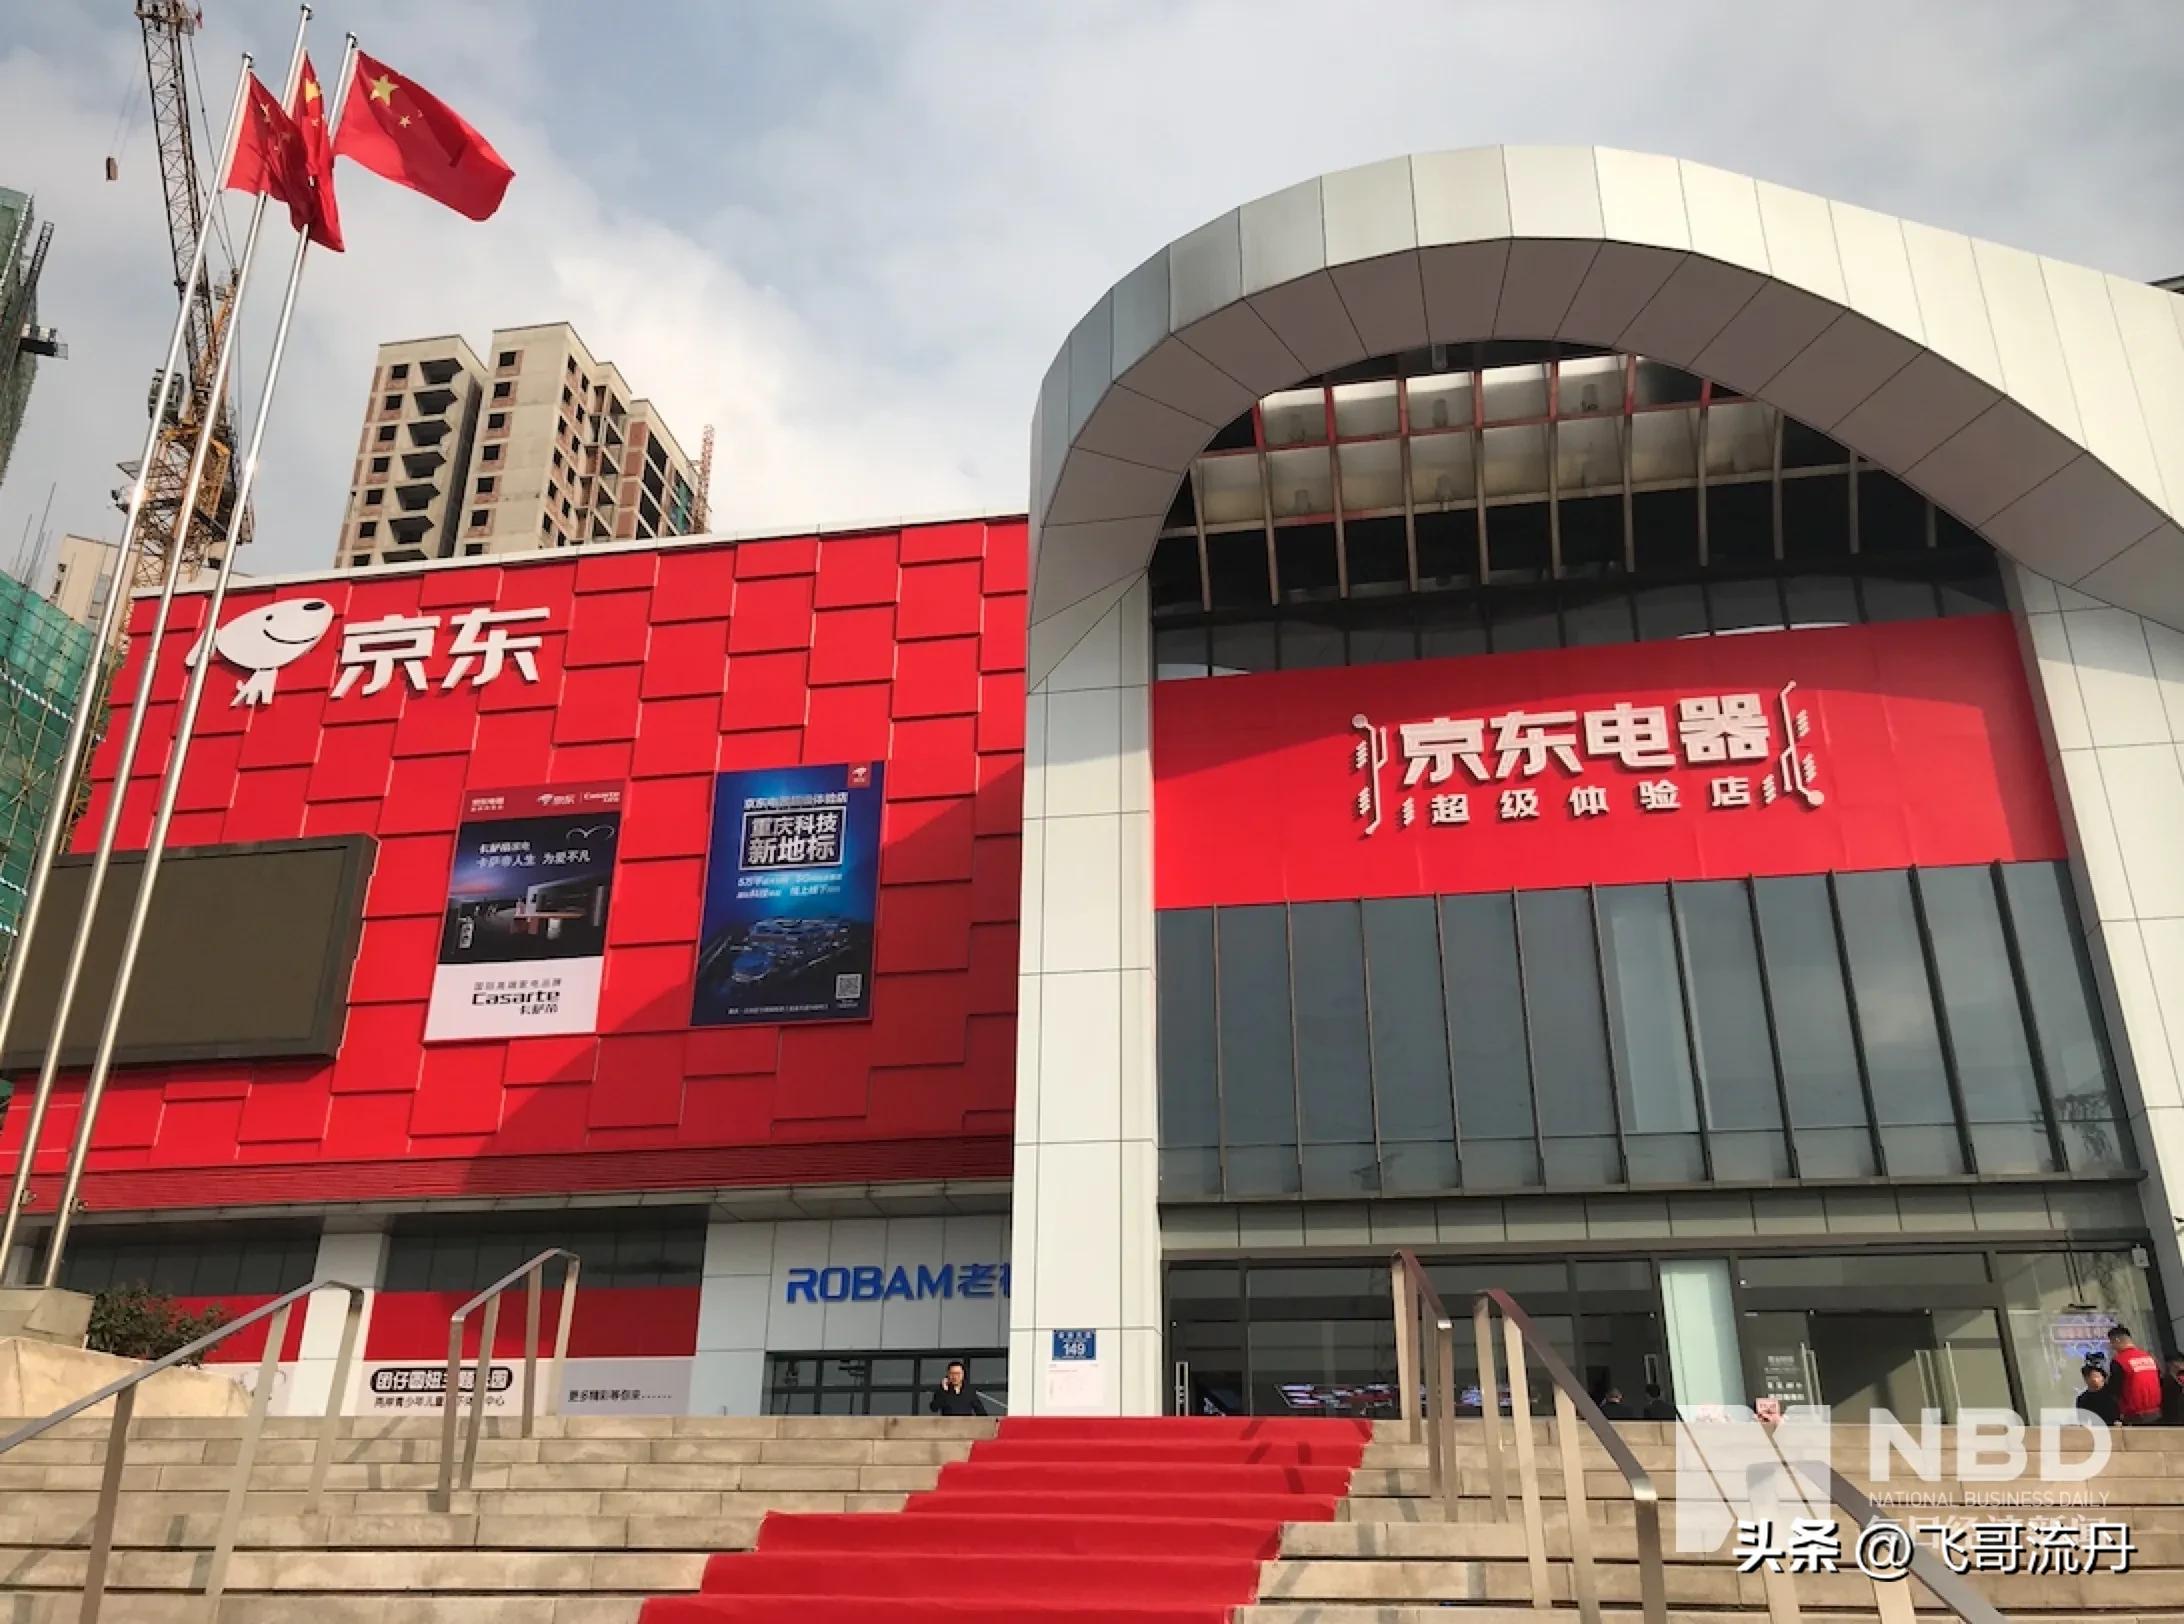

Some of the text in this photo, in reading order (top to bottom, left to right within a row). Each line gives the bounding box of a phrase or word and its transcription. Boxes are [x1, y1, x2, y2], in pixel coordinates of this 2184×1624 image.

[330, 607, 550, 698] 京东
[1400, 693, 1770, 786] 京东电器
[1431, 775, 1751, 825] 超级体验店
[751, 811, 838, 837] 重庆科技
[748, 833, 836, 864] 新地标
[472, 990, 560, 1005] Casarte
[1063, 1342, 1086, 1356] 149
